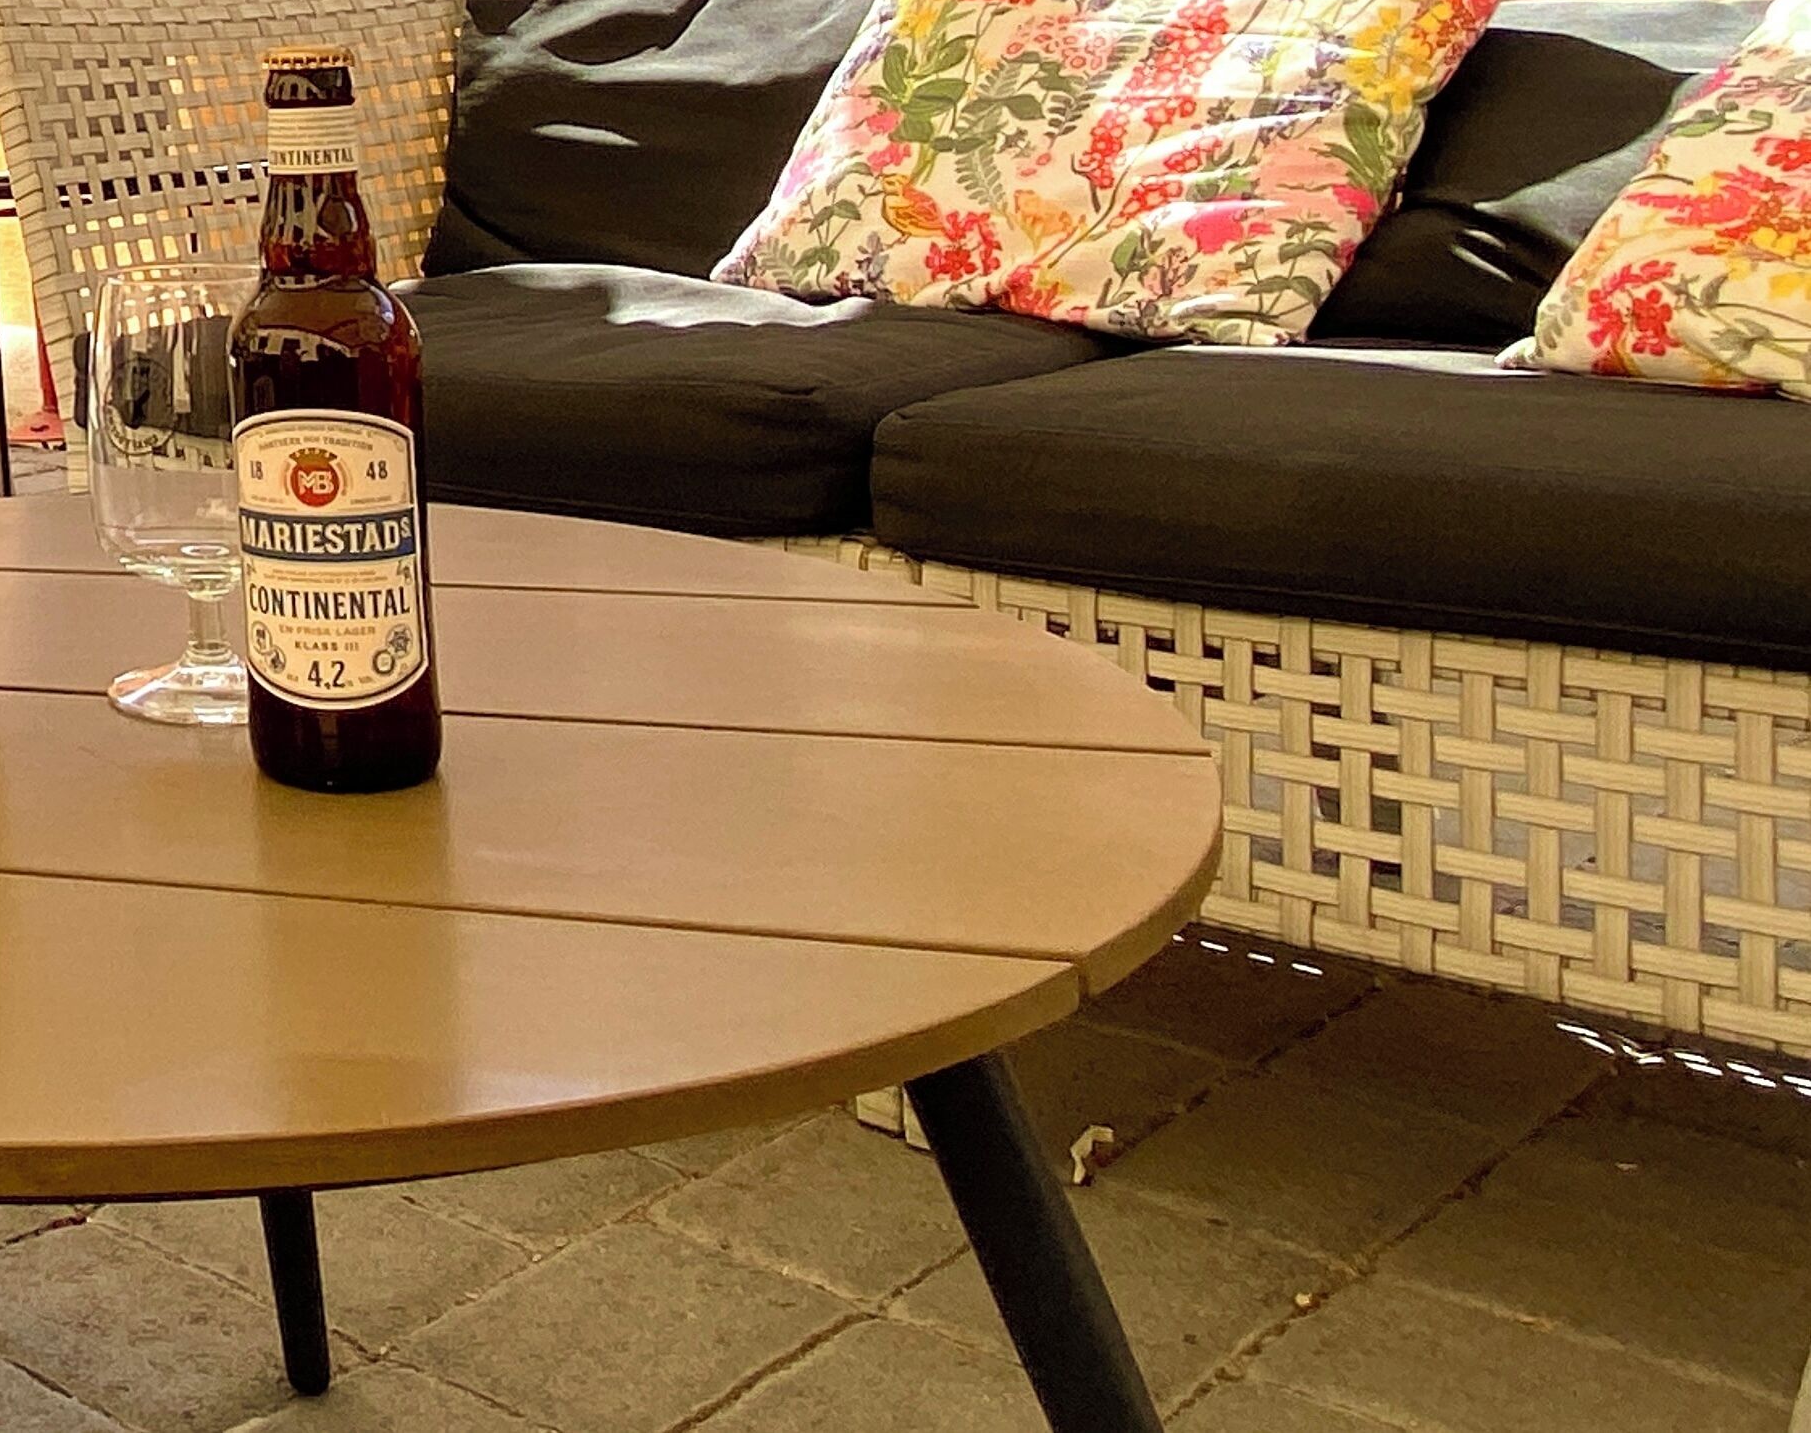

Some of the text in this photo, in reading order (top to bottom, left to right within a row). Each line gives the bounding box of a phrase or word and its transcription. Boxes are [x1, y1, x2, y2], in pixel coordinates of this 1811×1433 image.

[250, 460, 388, 480] 18 48
[241, 516, 412, 554] MARIESTADS
[249, 583, 411, 620] CONTINENTAL
[336, 626, 376, 636] LAGER
[295, 641, 338, 651] KLASS
